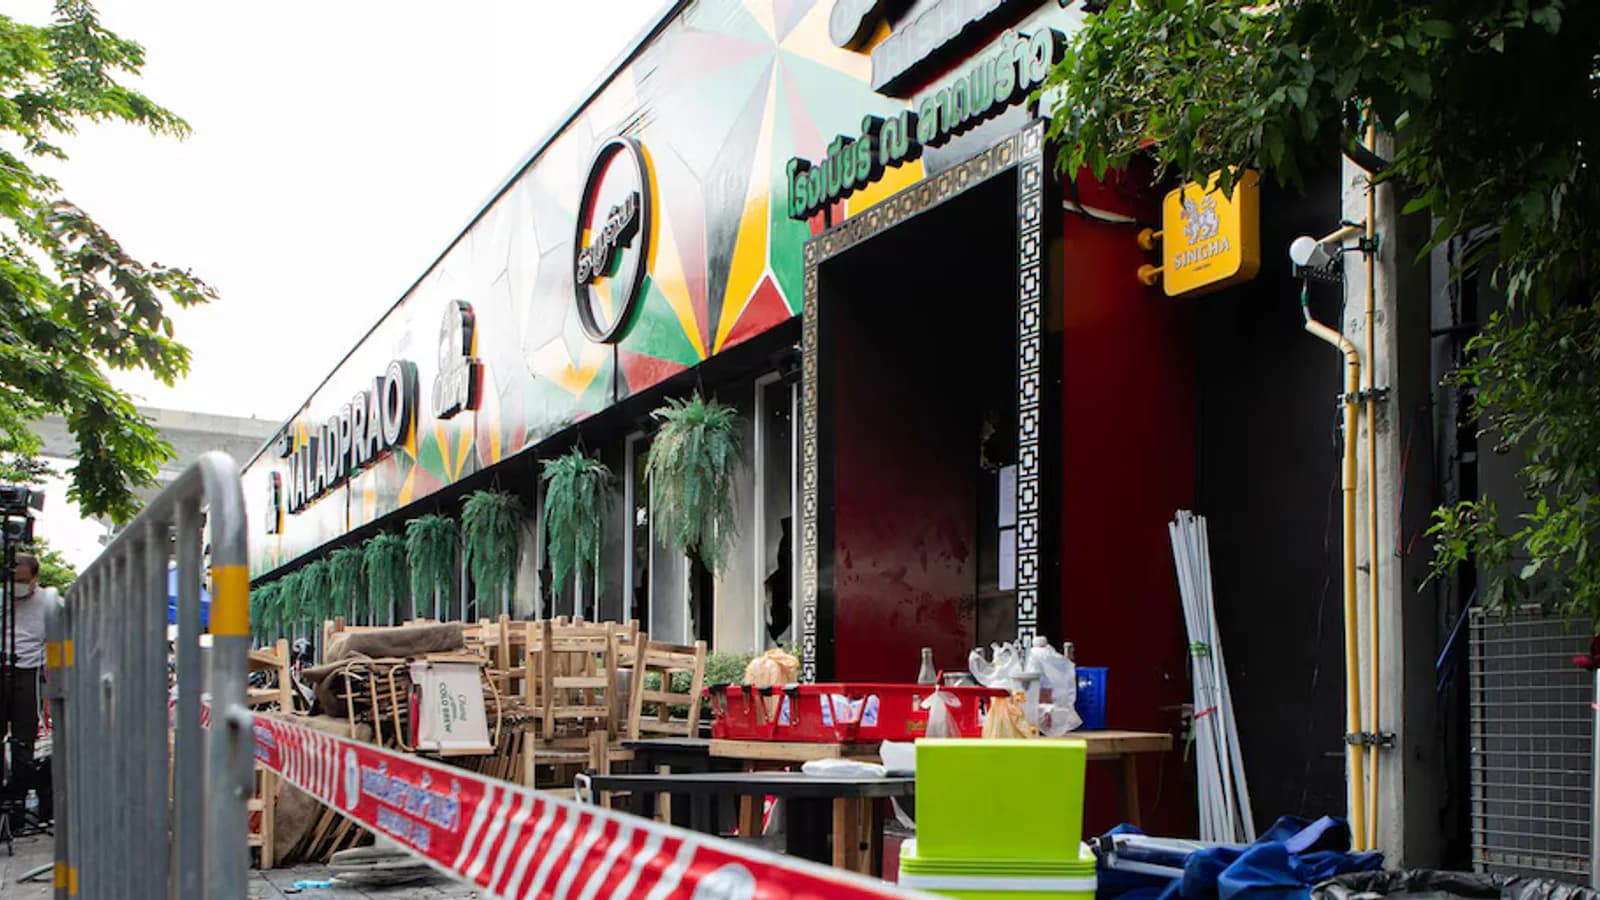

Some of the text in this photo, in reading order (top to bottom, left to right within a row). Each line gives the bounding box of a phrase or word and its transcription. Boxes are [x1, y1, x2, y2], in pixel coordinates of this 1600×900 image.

[786, 28, 1053, 220] โรงเบียร์ ณ ลาดพร้าว
[1173, 235, 1231, 271] SINGHA
[440, 682, 449, 706] COLD
